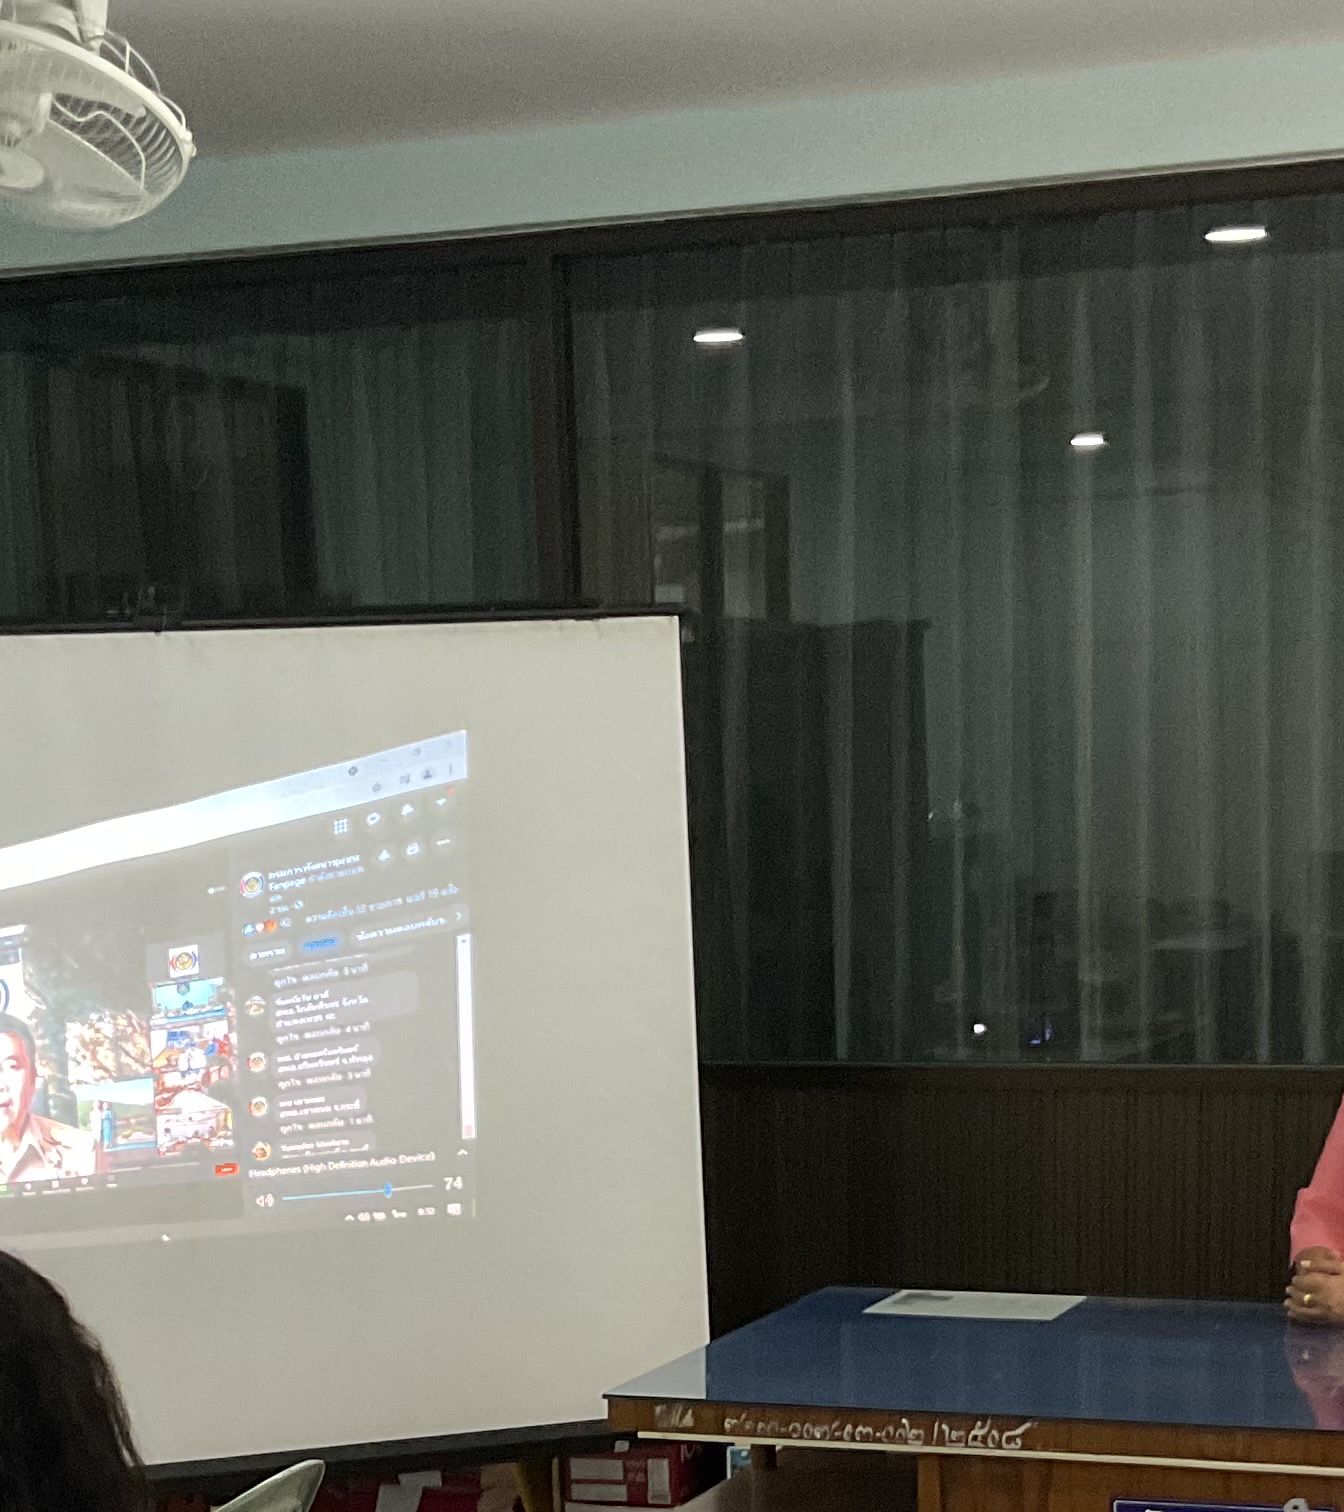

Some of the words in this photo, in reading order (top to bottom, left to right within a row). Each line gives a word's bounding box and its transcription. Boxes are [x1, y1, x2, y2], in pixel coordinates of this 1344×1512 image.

[249, 1164, 302, 1178] Headphones
[303, 1163, 327, 1175] (High
[328, 1158, 368, 1171] Definition
[369, 1156, 397, 1167] Audio
[399, 1151, 436, 1165] Device)
[444, 1176, 463, 1191] 74
